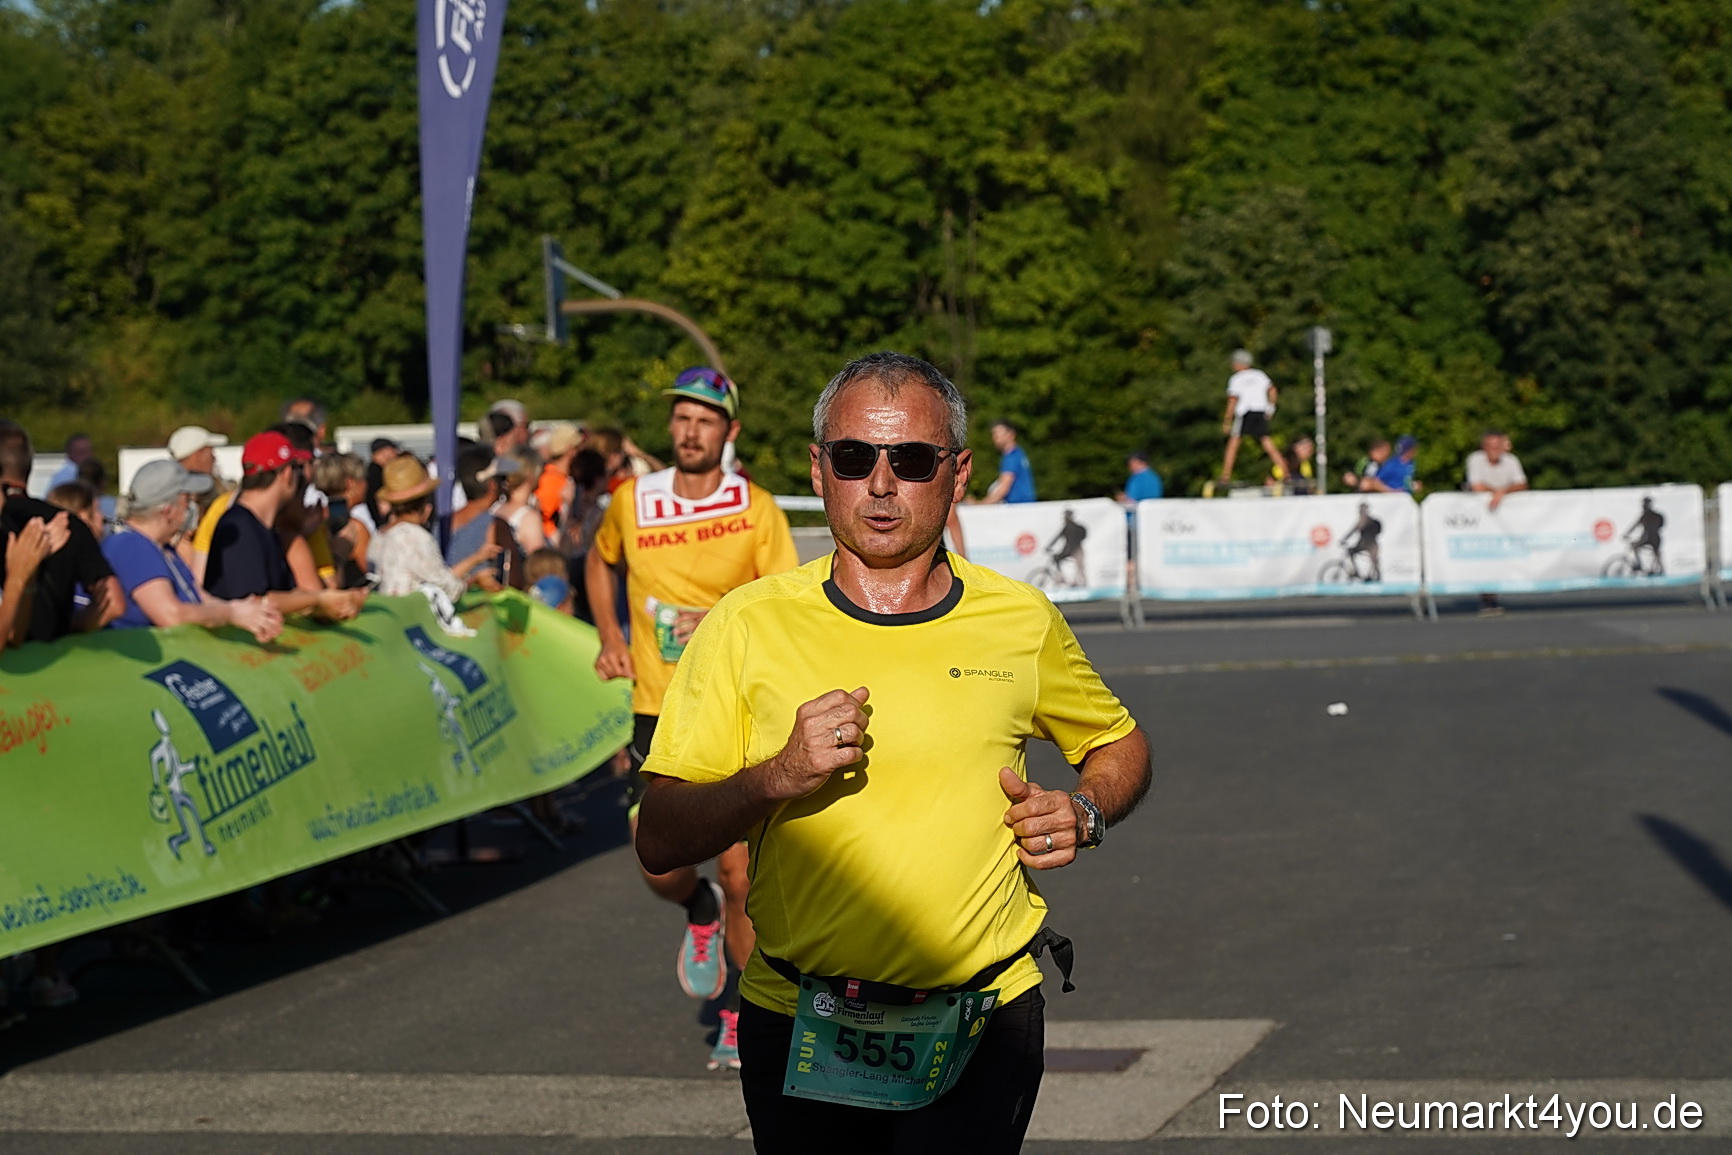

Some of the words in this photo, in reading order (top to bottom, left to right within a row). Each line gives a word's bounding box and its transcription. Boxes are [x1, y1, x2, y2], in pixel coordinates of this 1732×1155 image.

[637, 530, 687, 549] MAX
[697, 517, 753, 542] BÖGL
[963, 669, 1014, 679] SPANGLER
[194, 701, 316, 822] firmenlauf
[837, 1006, 886, 1021] Firmenlauf
[853, 1018, 885, 1026] neumarkt
[964, 1006, 973, 1022] AOK
[797, 1031, 817, 1074] RUN
[833, 1027, 916, 1072] 555
[812, 1062, 889, 1084] Spangler-Lang
[891, 1074, 928, 1086] Michael
[925, 1040, 948, 1092] 2022
